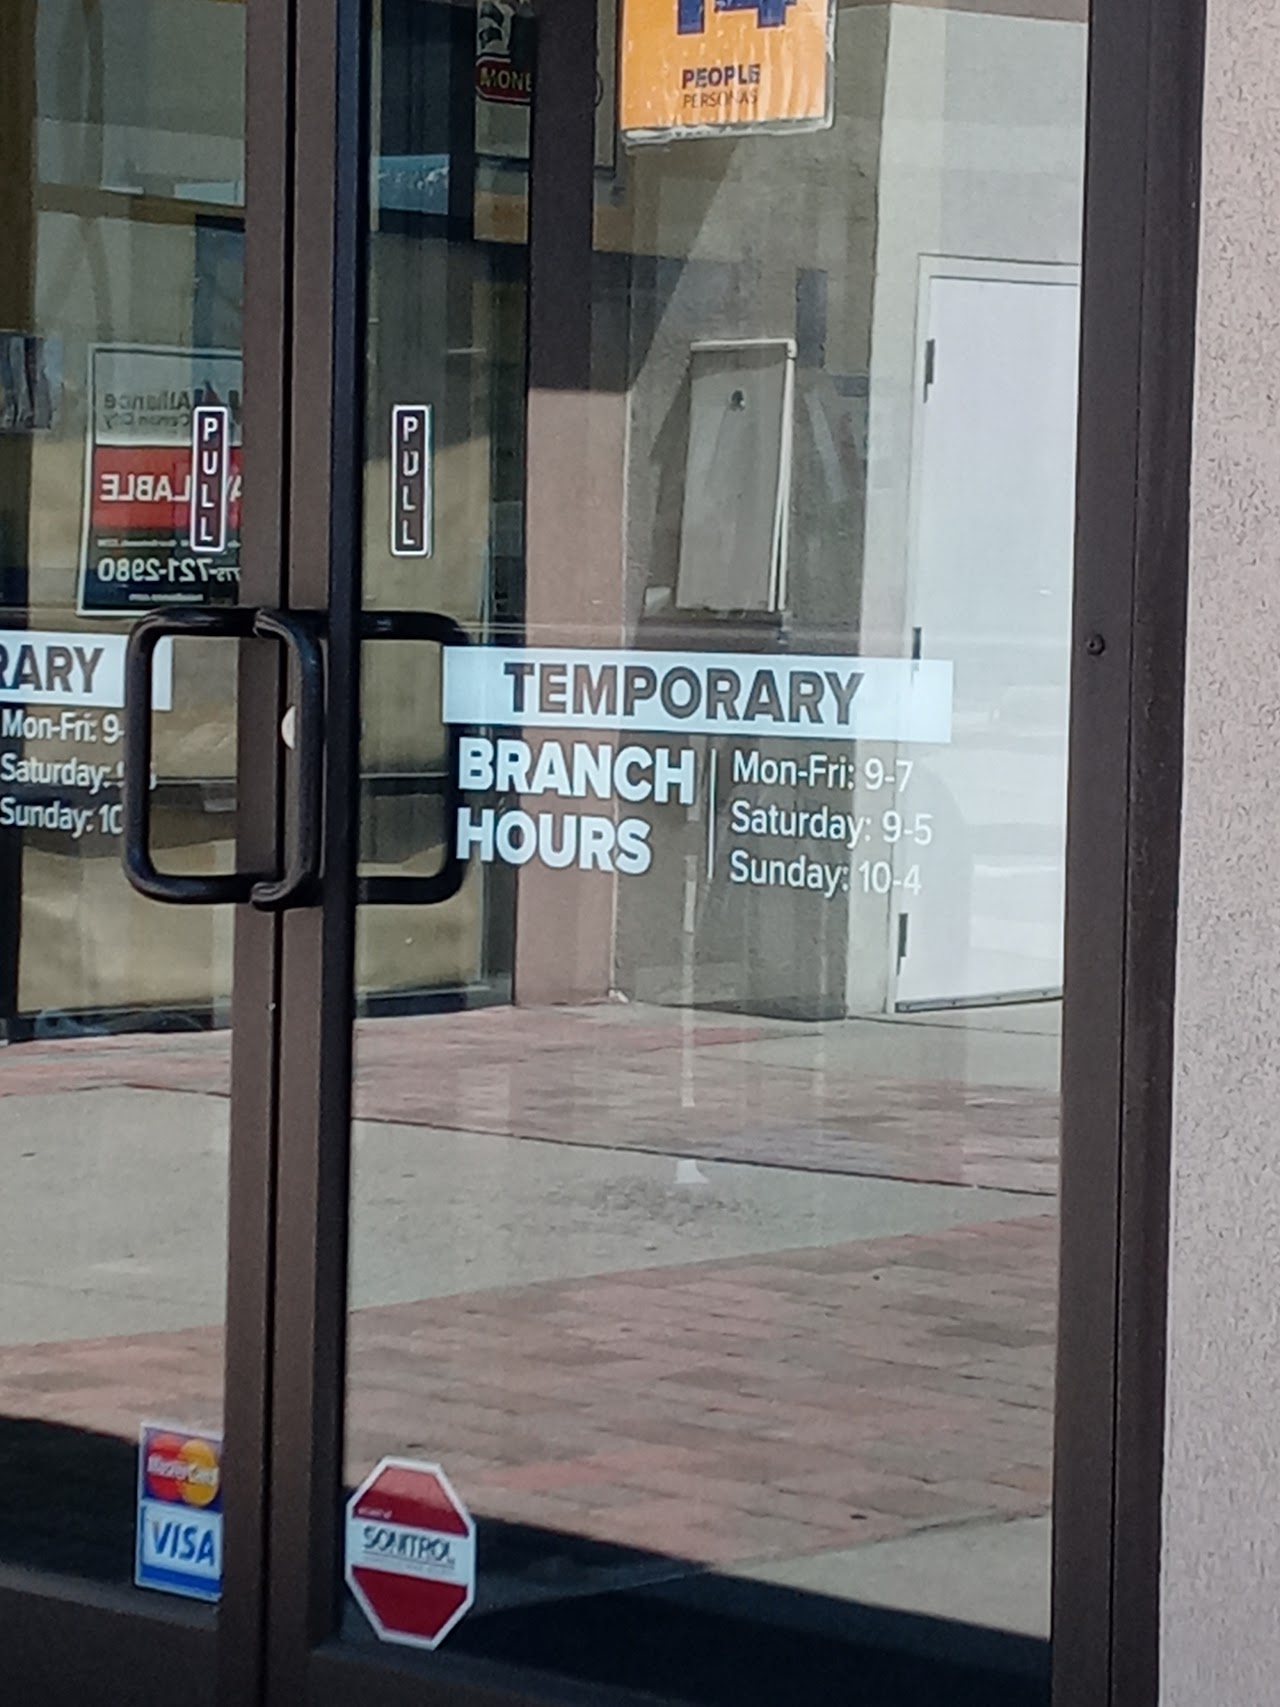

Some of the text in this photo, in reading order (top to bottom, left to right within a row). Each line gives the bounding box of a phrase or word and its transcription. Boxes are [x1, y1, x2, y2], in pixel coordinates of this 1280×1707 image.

[682, 64, 761, 89] PEOPLE
[201, 417, 219, 542] PULL
[402, 416, 419, 545] PULL
[503, 661, 865, 725] TEMPORARY
[2, 710, 125, 744] Mon-Fri: 9-
[0, 752, 111, 795] Saturday:
[457, 736, 695, 805] BRANCH
[732, 749, 914, 793] Mon-Fri: 9-7
[0, 796, 124, 839] Sunday: 10
[456, 806, 653, 875] HOURS
[730, 800, 933, 850] Saturday: 9-5
[729, 849, 922, 899] Sunday: 10-4
[152, 1521, 215, 1567] VISA
